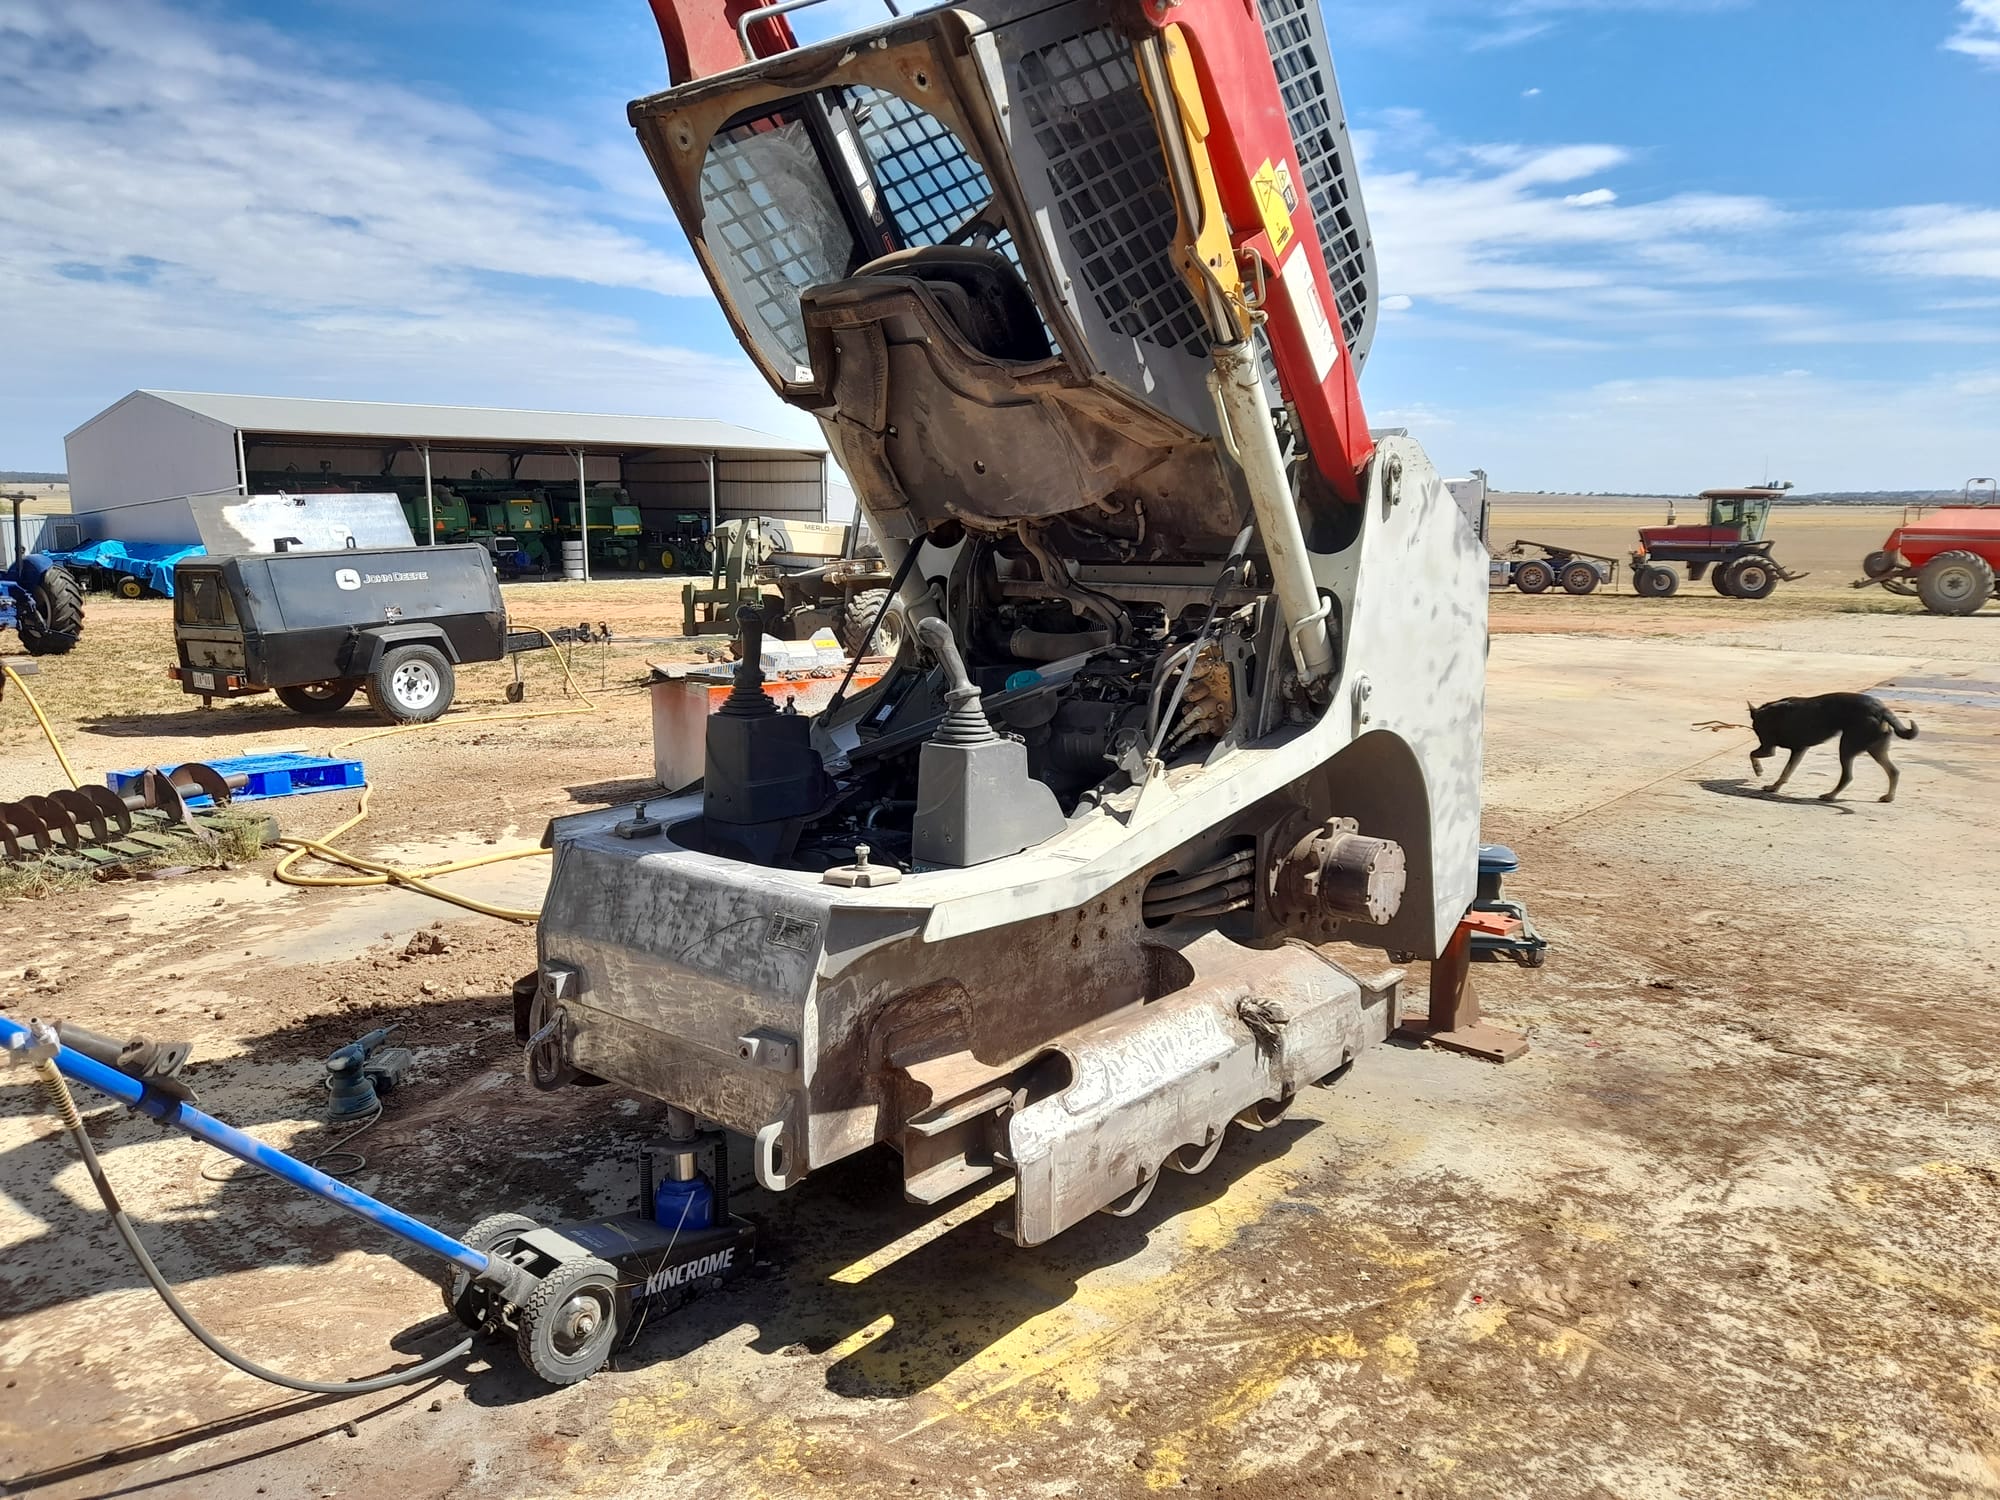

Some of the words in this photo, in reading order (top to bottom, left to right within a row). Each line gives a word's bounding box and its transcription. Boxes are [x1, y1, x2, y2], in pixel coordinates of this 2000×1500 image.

[804, 523, 830, 532] MERLO
[363, 573, 393, 584] JOHN
[393, 571, 429, 582] DEERE
[645, 1246, 735, 1297] KINCROME
